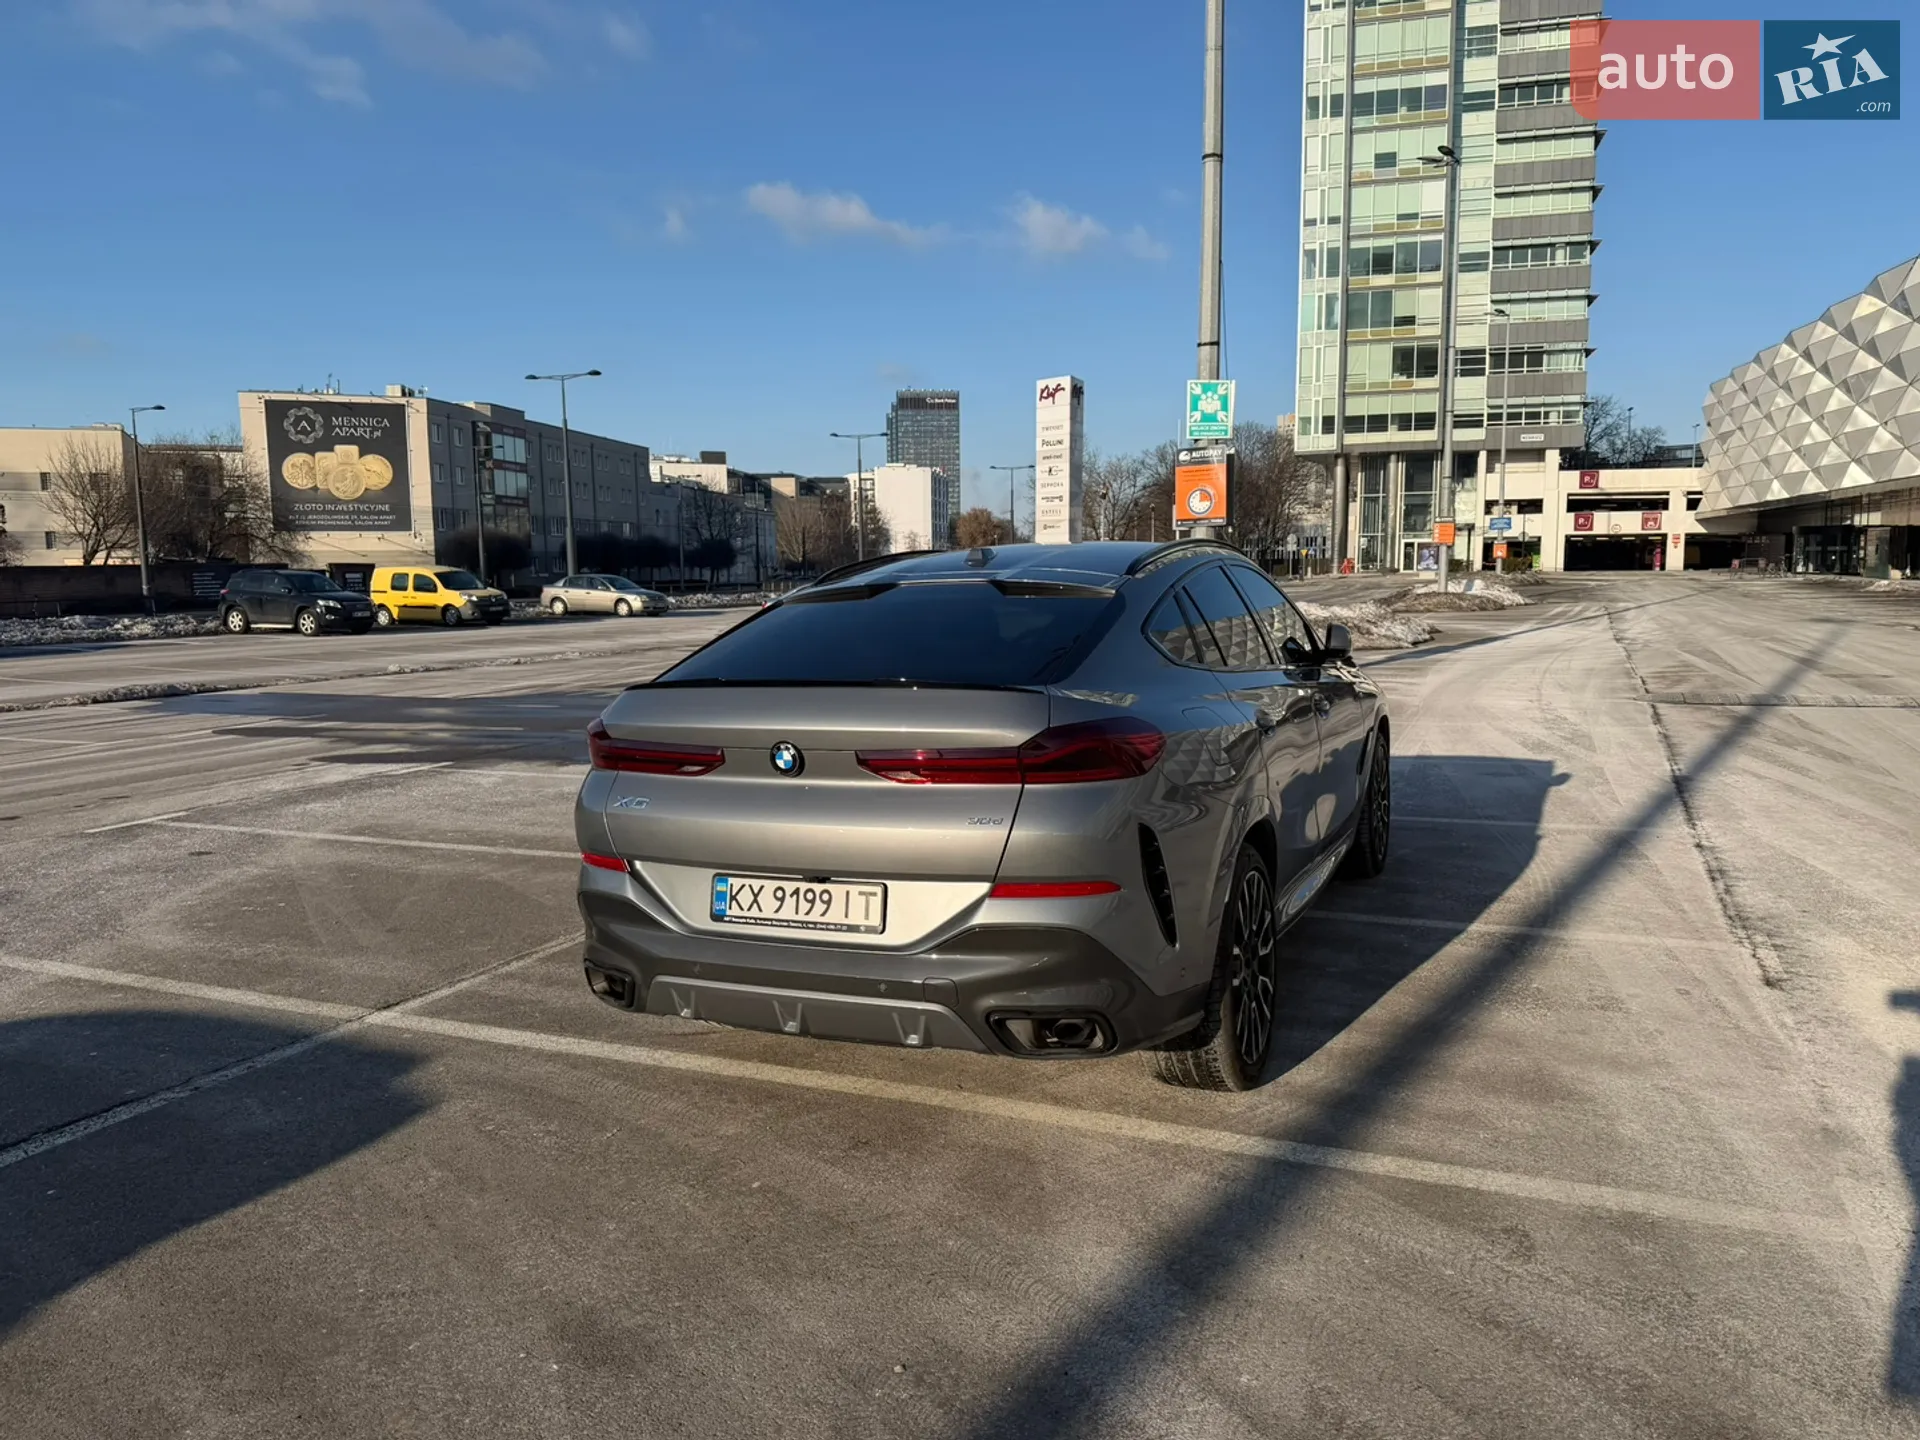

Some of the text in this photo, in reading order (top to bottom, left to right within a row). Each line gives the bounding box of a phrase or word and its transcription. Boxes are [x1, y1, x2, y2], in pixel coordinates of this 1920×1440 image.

[331, 416, 390, 427] MENNICA
[331, 427, 382, 439] APART.pl
[1192, 449, 1223, 458] AUTOPAY
[325, 503, 391, 512] INWESTYCYJNE
[612, 796, 651, 808] X6
[715, 900, 726, 911] UA
[729, 883, 878, 921] KX 9199 IT
